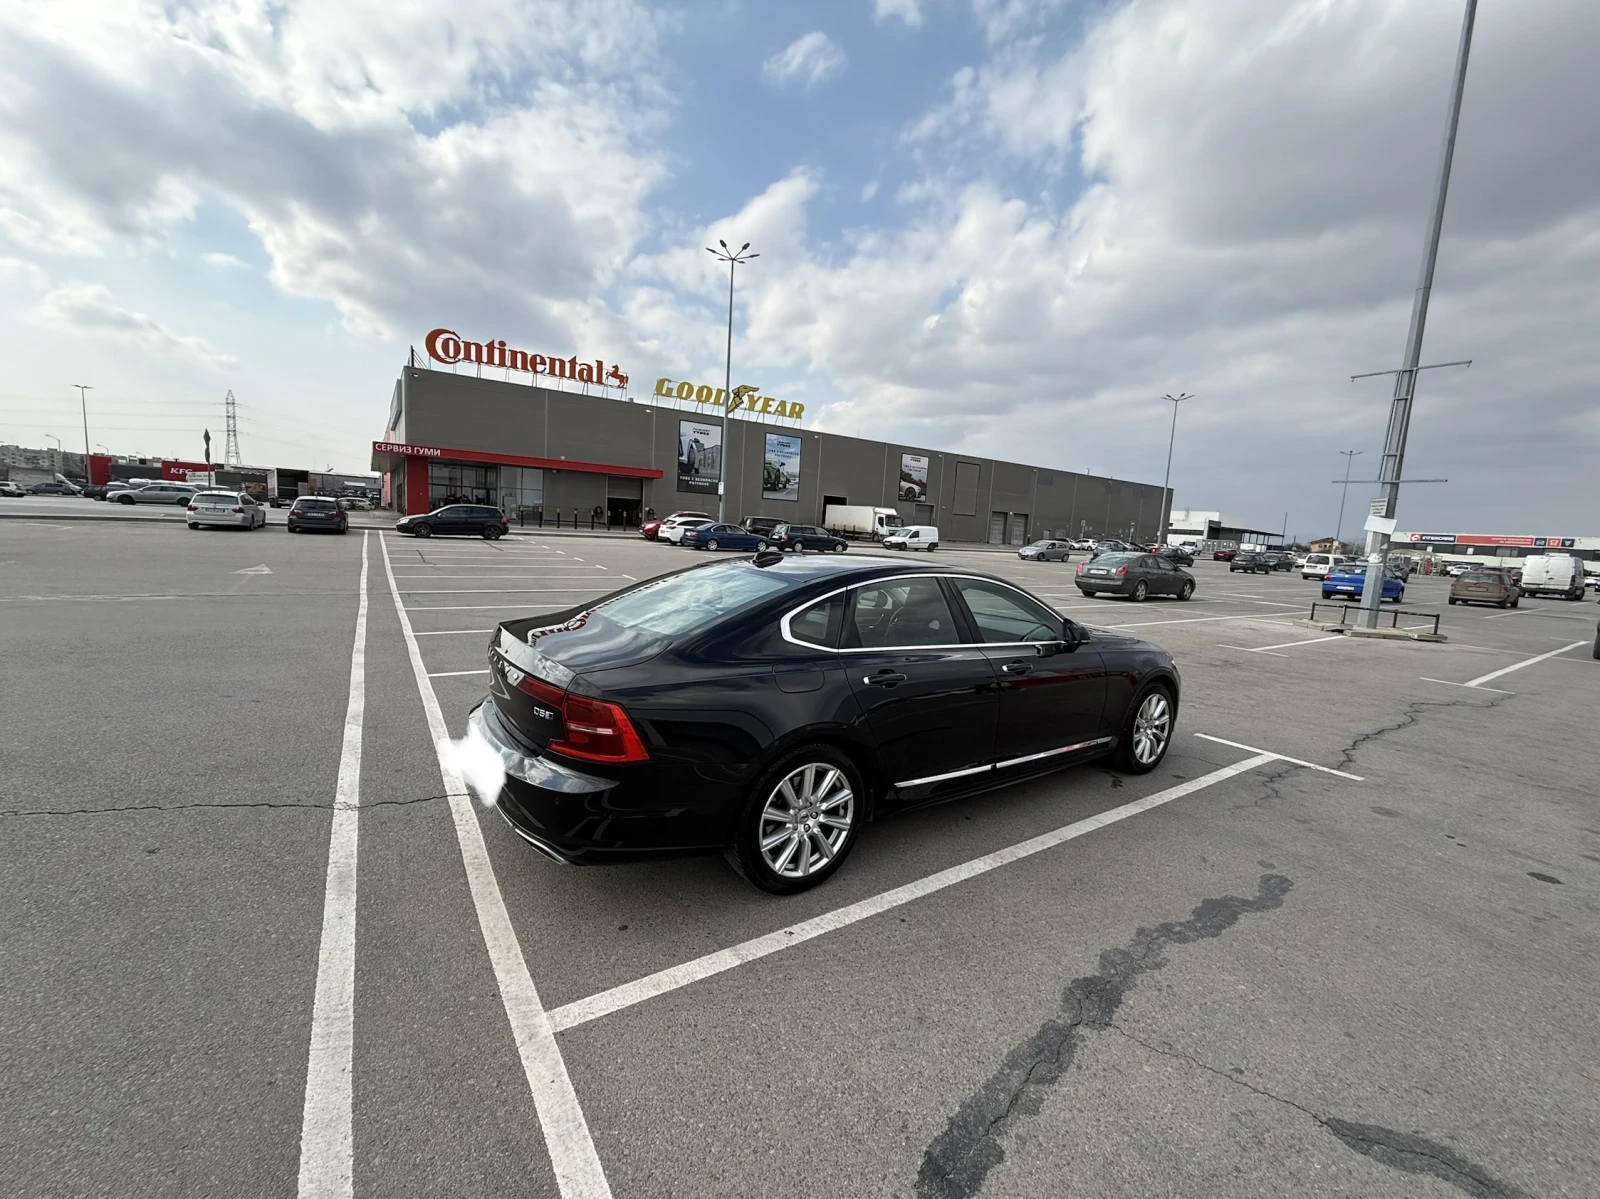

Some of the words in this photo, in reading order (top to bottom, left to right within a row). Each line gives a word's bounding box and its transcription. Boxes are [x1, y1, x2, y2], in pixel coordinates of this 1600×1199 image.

[425, 328, 604, 385] Continental
[375, 443, 412, 454] СЕРВИЗ
[414, 447, 441, 456] ГУМИ
